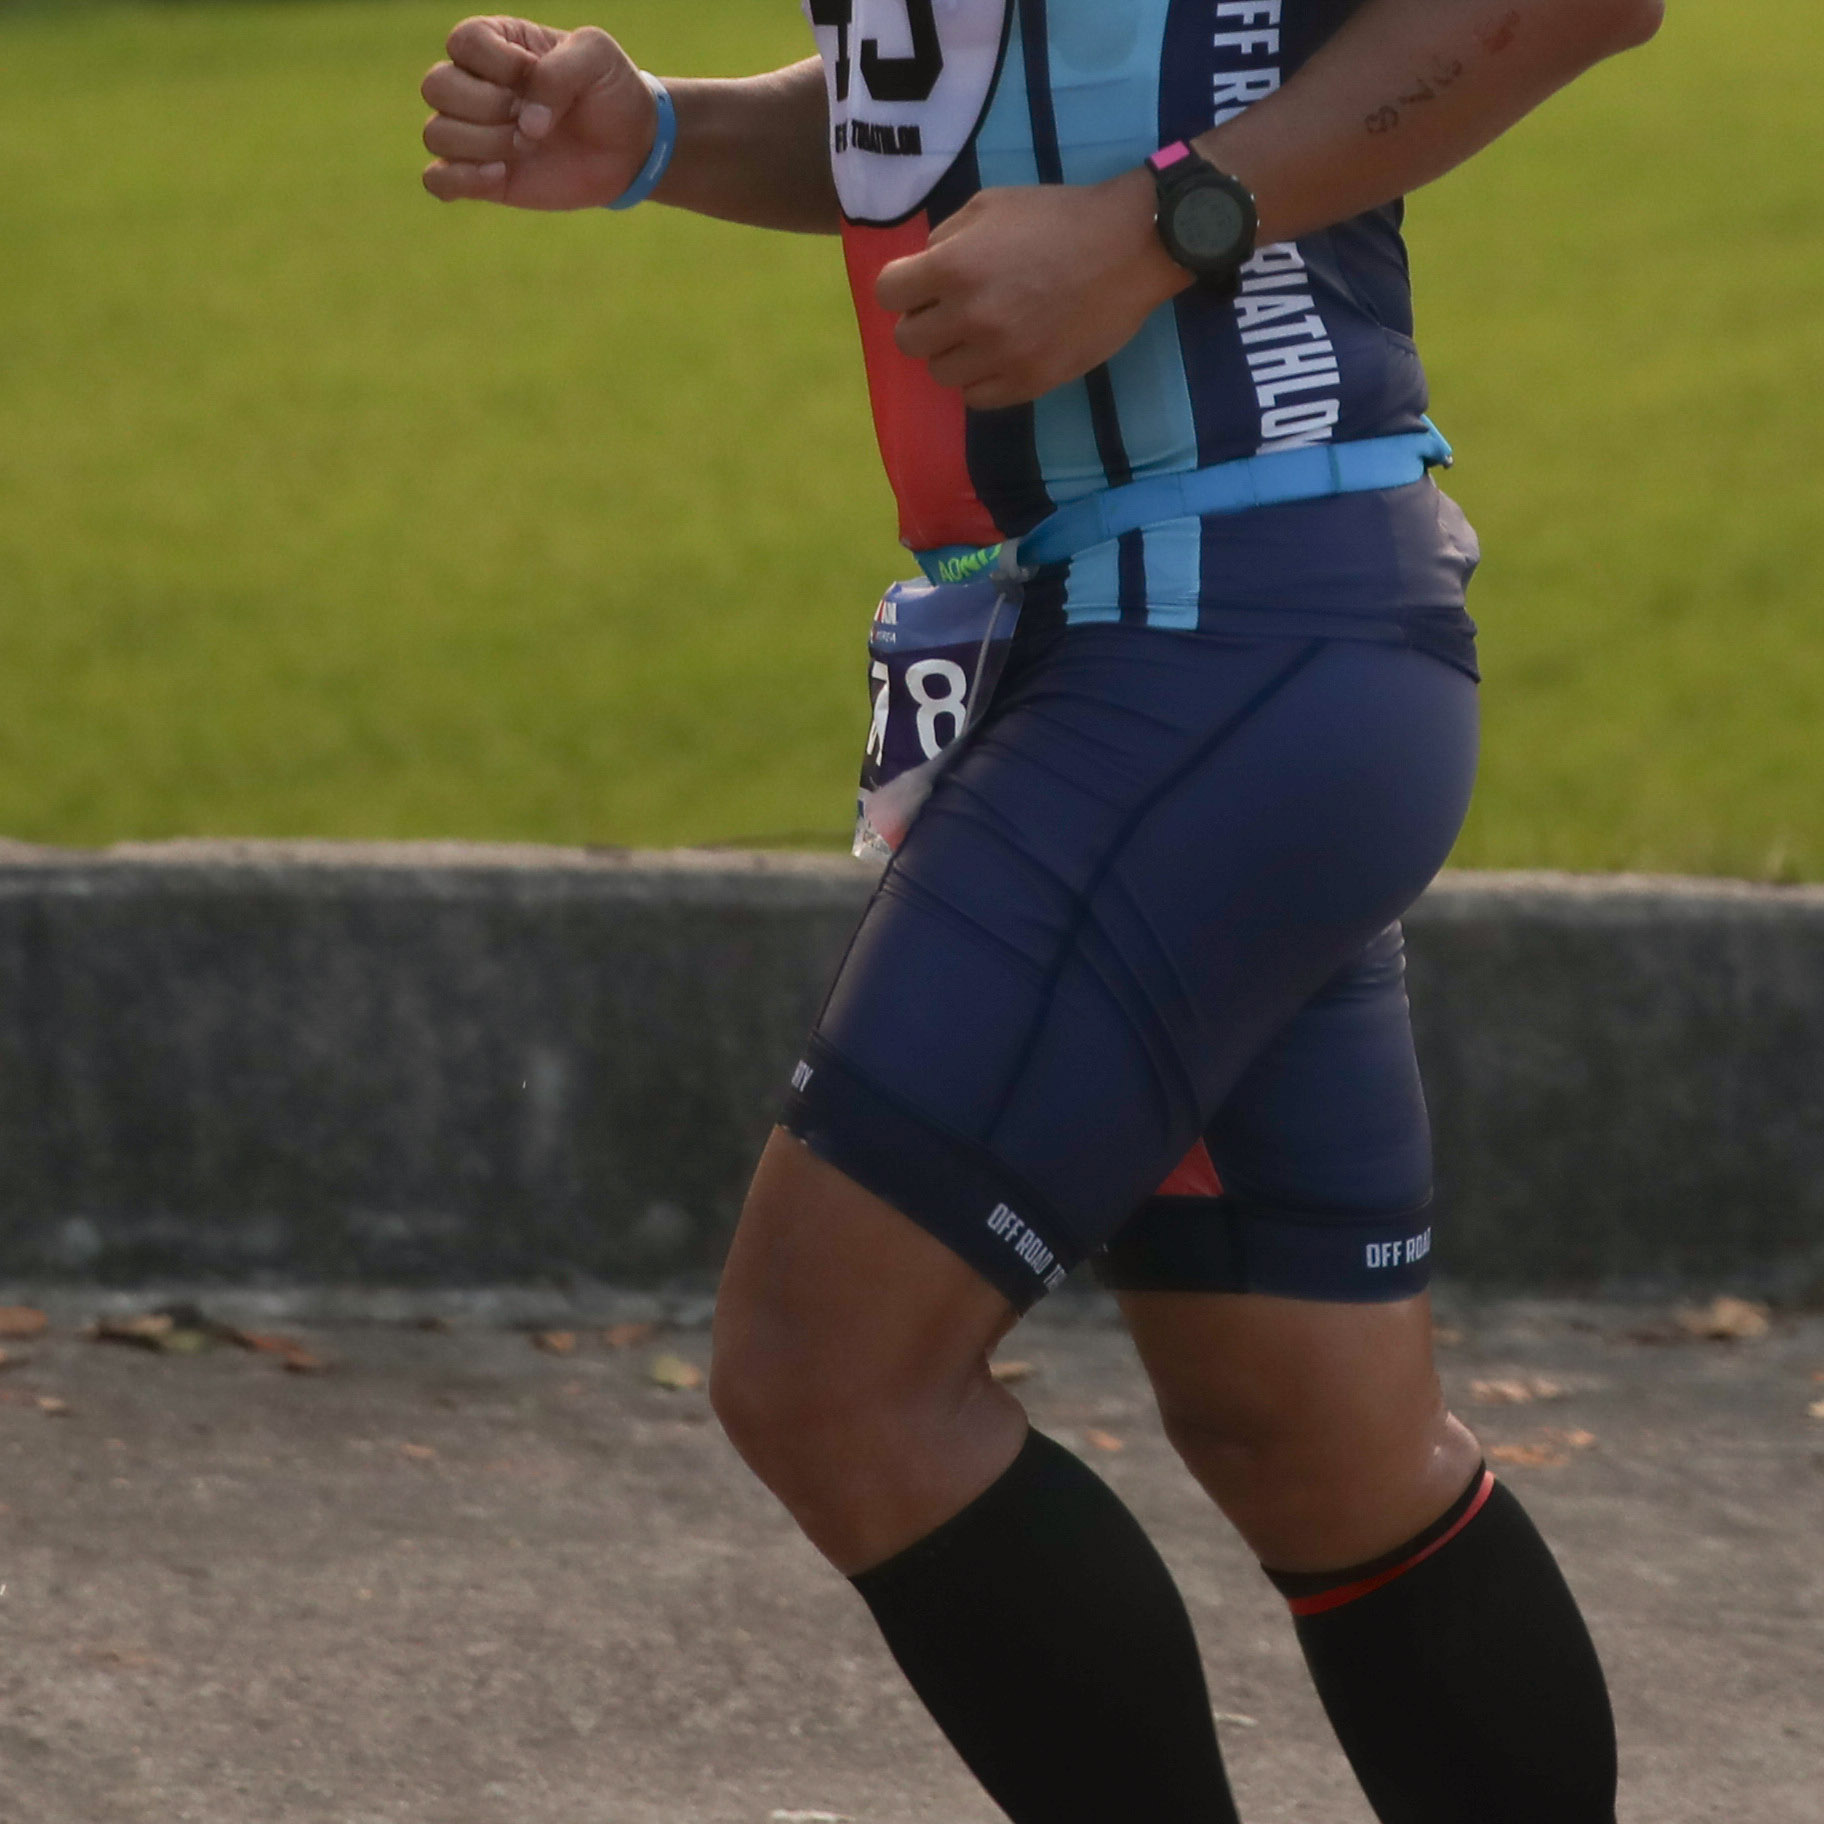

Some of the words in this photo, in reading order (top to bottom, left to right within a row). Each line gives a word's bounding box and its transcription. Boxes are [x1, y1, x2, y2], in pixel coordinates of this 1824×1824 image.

[1232, 241, 1342, 456] RIATHLO
[986, 1202, 1025, 1243] OFF
[1014, 1228, 1055, 1275] ROAD
[1365, 1240, 1403, 1269] OFF
